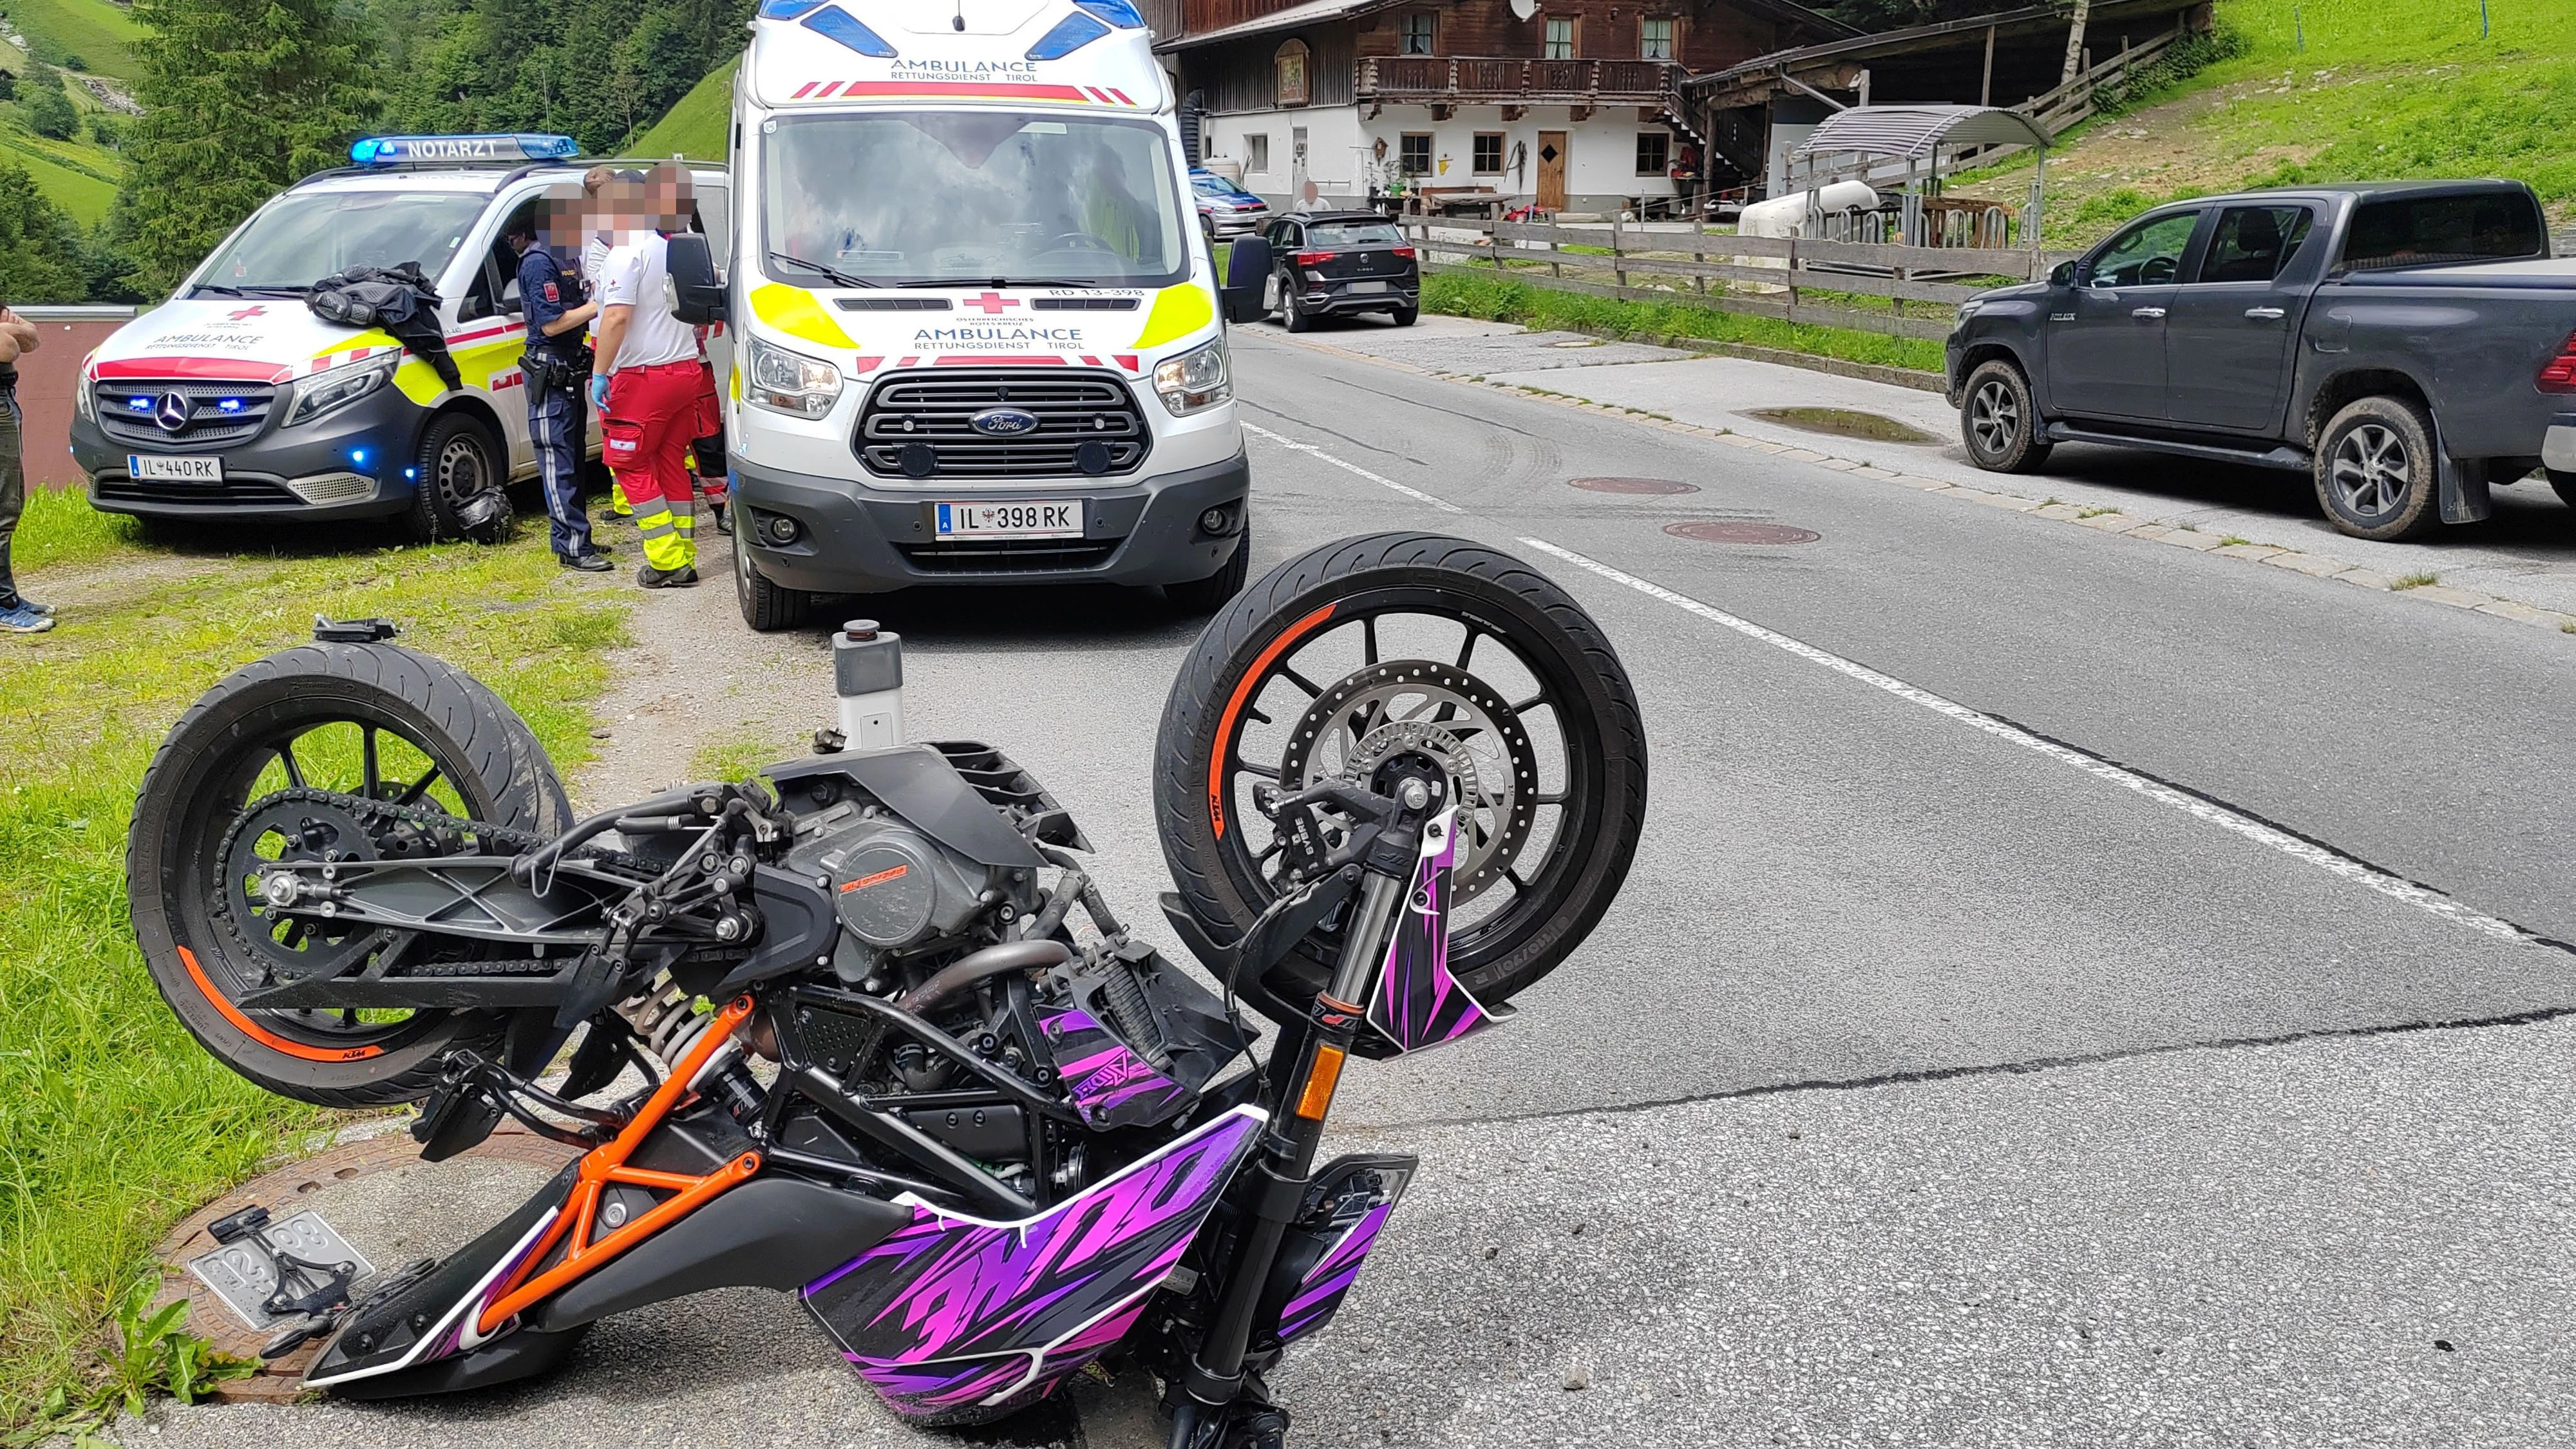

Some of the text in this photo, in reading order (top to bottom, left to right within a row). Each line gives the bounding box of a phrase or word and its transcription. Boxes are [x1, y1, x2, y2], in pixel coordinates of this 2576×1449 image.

[891, 59, 1037, 73] AMBULANCE
[891, 71, 1038, 82] RETTUNGSDIENST TIROL
[408, 140, 497, 158] NOTARZT
[153, 334, 263, 345] AMBULANCE
[914, 328, 1083, 341] AMBULANCE
[914, 341, 1085, 350] RETTUNGSDIENST TIROL
[987, 414, 1023, 431] Ford
[144, 459, 156, 475] IL
[166, 460, 192, 477] 440
[194, 460, 214, 477] RK
[960, 507, 980, 529] IL
[997, 506, 1037, 529] 398
[1043, 506, 1070, 527] RK
[1193, 661, 1237, 761] MICHELIN
[1210, 793, 1221, 822] KTM
[341, 1048, 366, 1059] KTM
